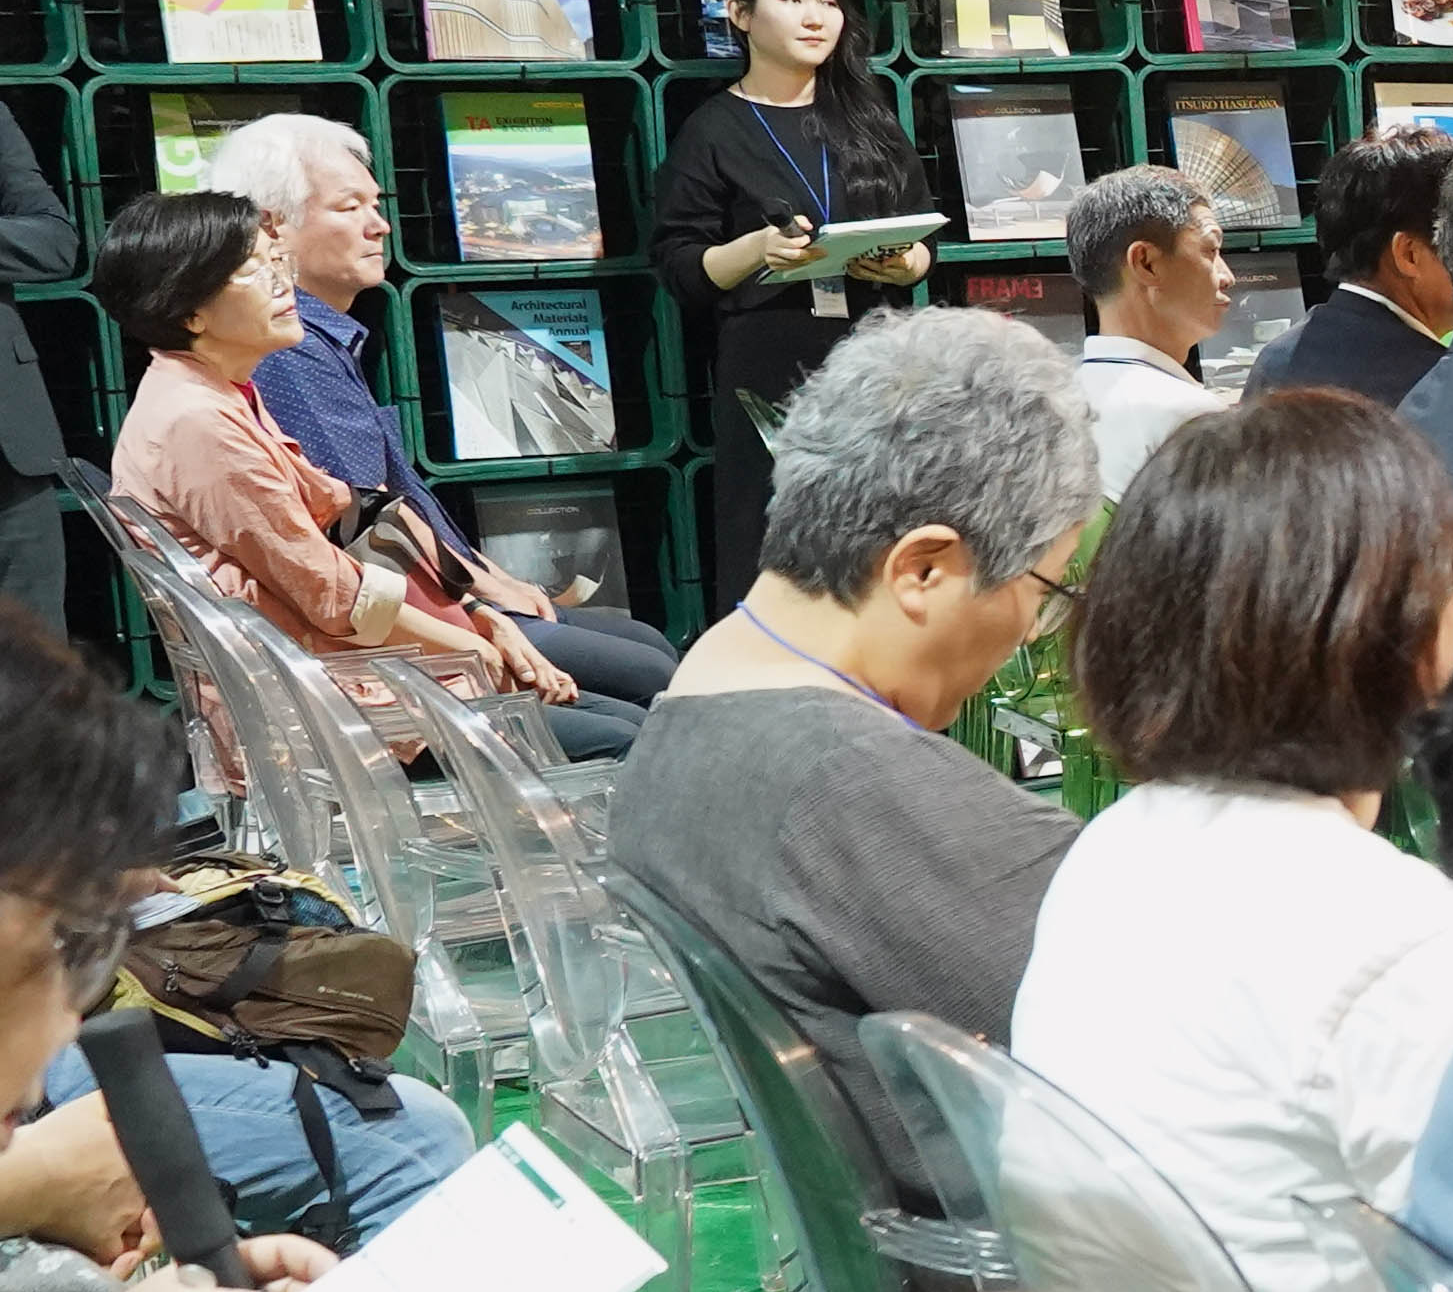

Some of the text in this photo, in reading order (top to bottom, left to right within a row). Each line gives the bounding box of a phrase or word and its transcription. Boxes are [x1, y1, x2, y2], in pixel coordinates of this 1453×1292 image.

[1175, 99, 1279, 110] ITSUKO HASEGAWA
[511, 297, 587, 311] Architectural
[533, 312, 589, 324] Materials
[548, 325, 590, 337] Annual
